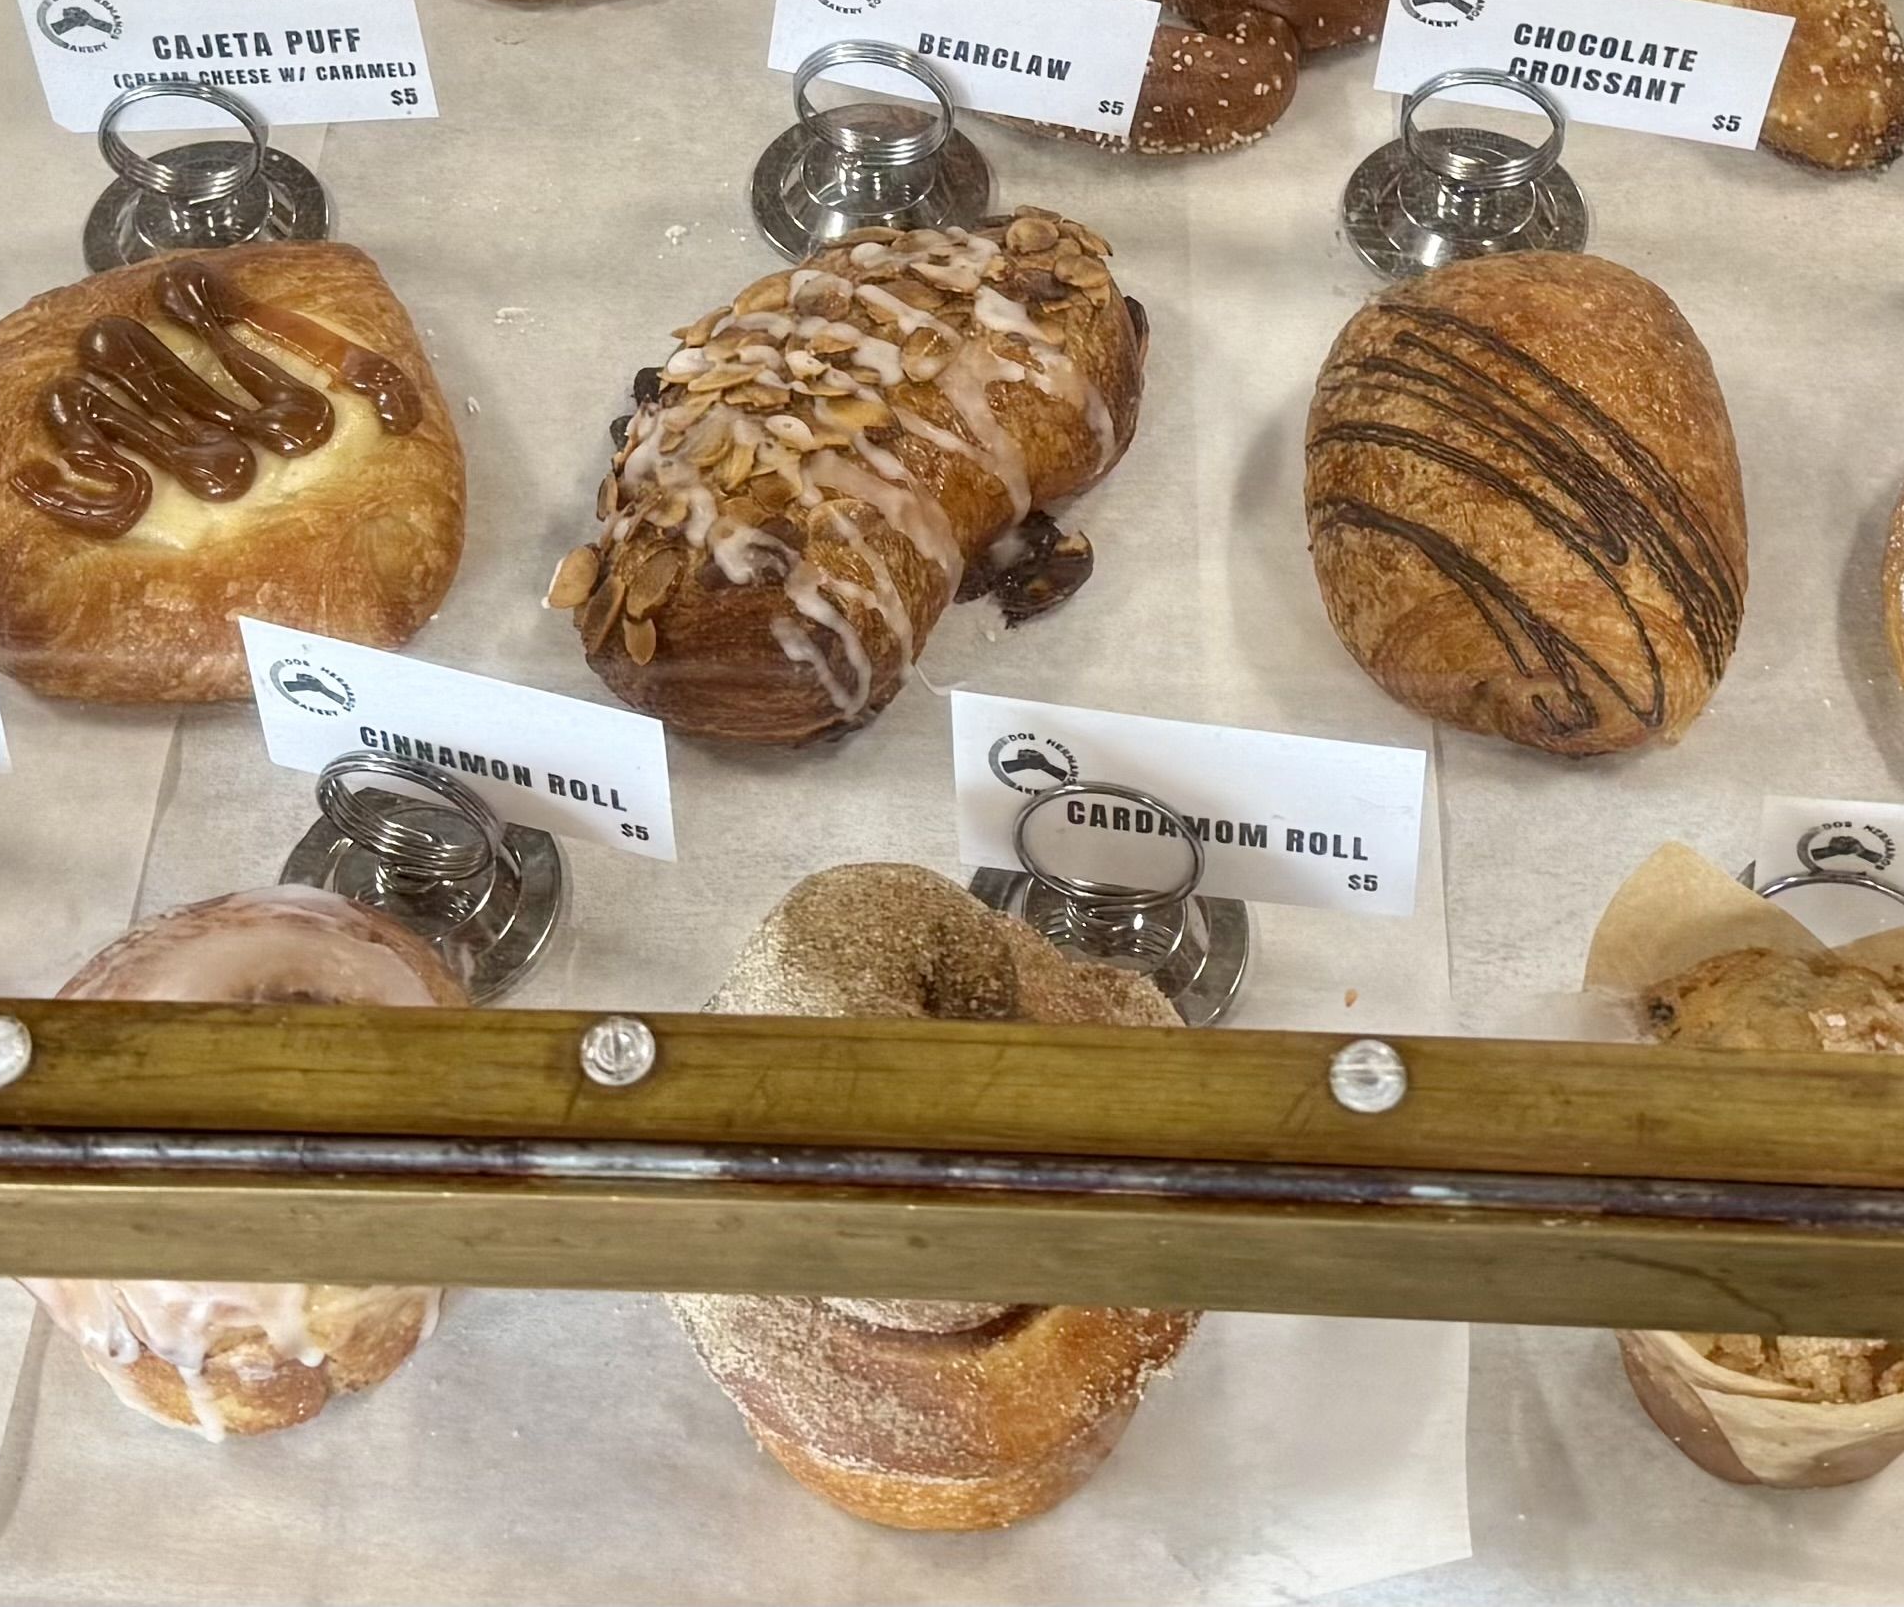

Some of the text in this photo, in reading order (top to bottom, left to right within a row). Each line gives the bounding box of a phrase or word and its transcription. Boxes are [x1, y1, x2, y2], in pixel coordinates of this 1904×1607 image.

[152, 27, 362, 60] CAJETA PUFF
[917, 32, 1072, 82] BEARCLAW
[1513, 22, 1698, 73] CHOCOLATE
[199, 68, 272, 89] CHEESE
[279, 67, 307, 82] W/
[316, 62, 417, 82] CARAMEL)
[1507, 56, 1686, 105] CROISSANT
[390, 88, 419, 106] $5
[1098, 99, 1125, 116] $5
[1712, 114, 1741, 133] $5
[360, 726, 628, 812] CINNAMON ROLL
[620, 822, 650, 842] $5
[1066, 799, 1369, 862] CARDAMOM ROLL
[1347, 874, 1378, 893] $5
